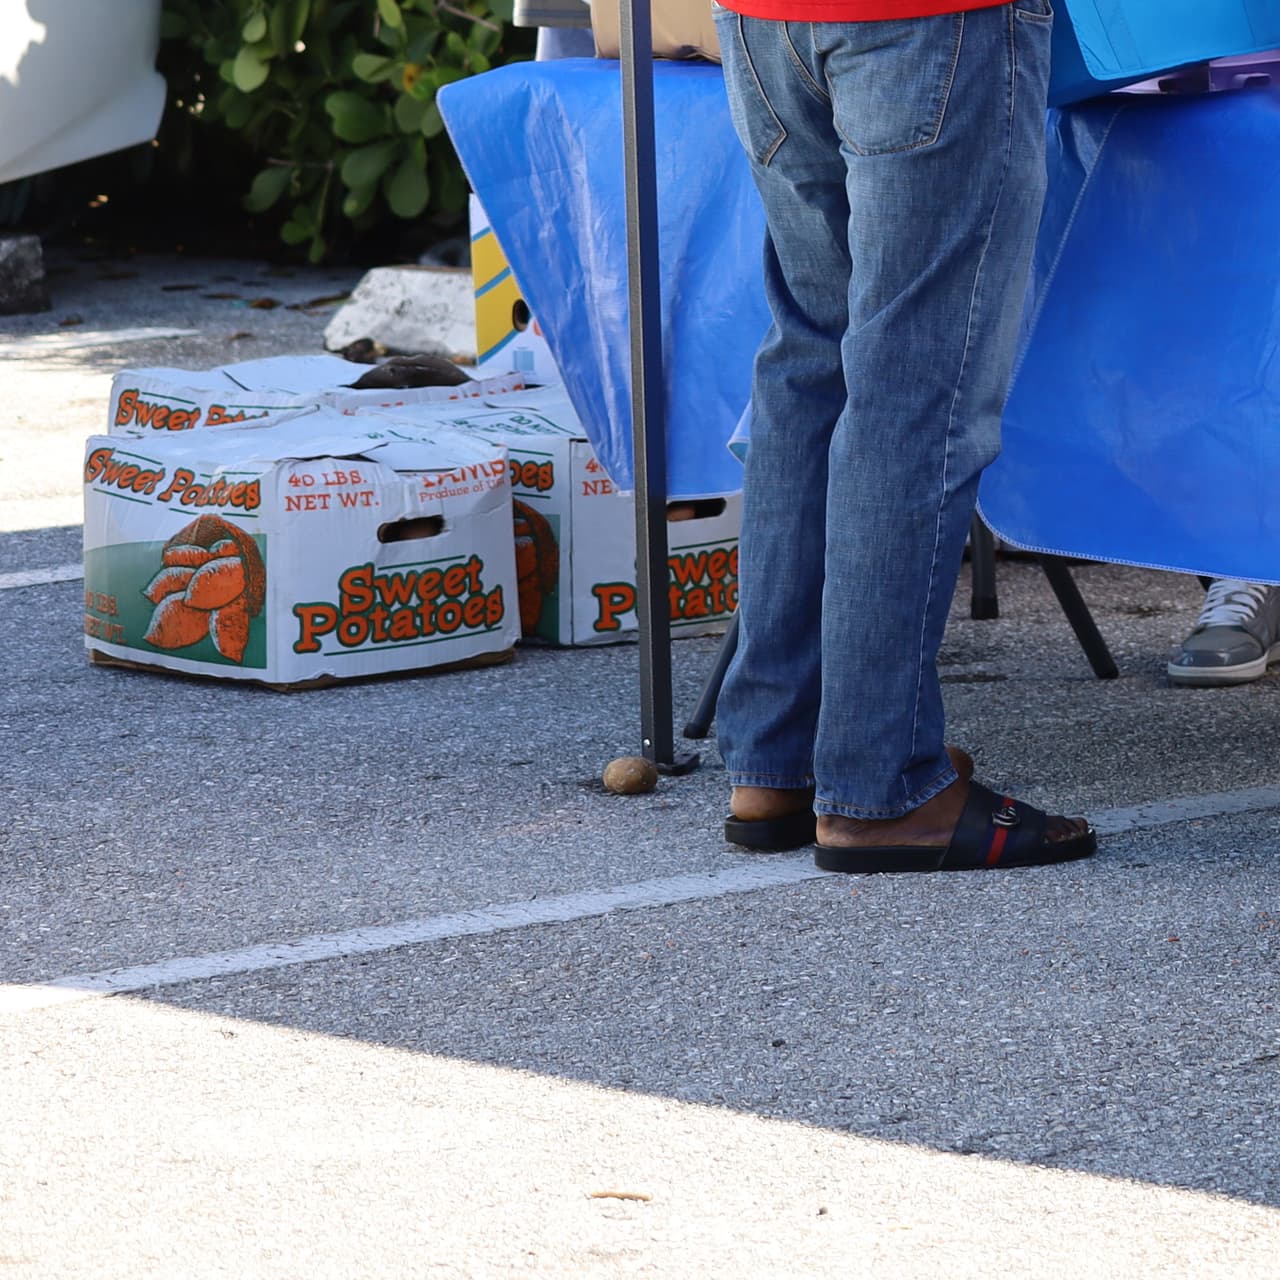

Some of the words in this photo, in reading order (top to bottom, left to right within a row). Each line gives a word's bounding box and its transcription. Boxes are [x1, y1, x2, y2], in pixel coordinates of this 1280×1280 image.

[115, 388, 201, 432] Sweet
[85, 447, 167, 496] Sweet
[288, 473, 316, 488] 40
[324, 471, 368, 487] LBS.
[419, 486, 470, 503] Produce
[473, 480, 484, 493] of
[285, 494, 331, 512] NET
[340, 491, 381, 508] WT.
[338, 554, 485, 617] Sweet
[292, 584, 505, 654] Potatoes
